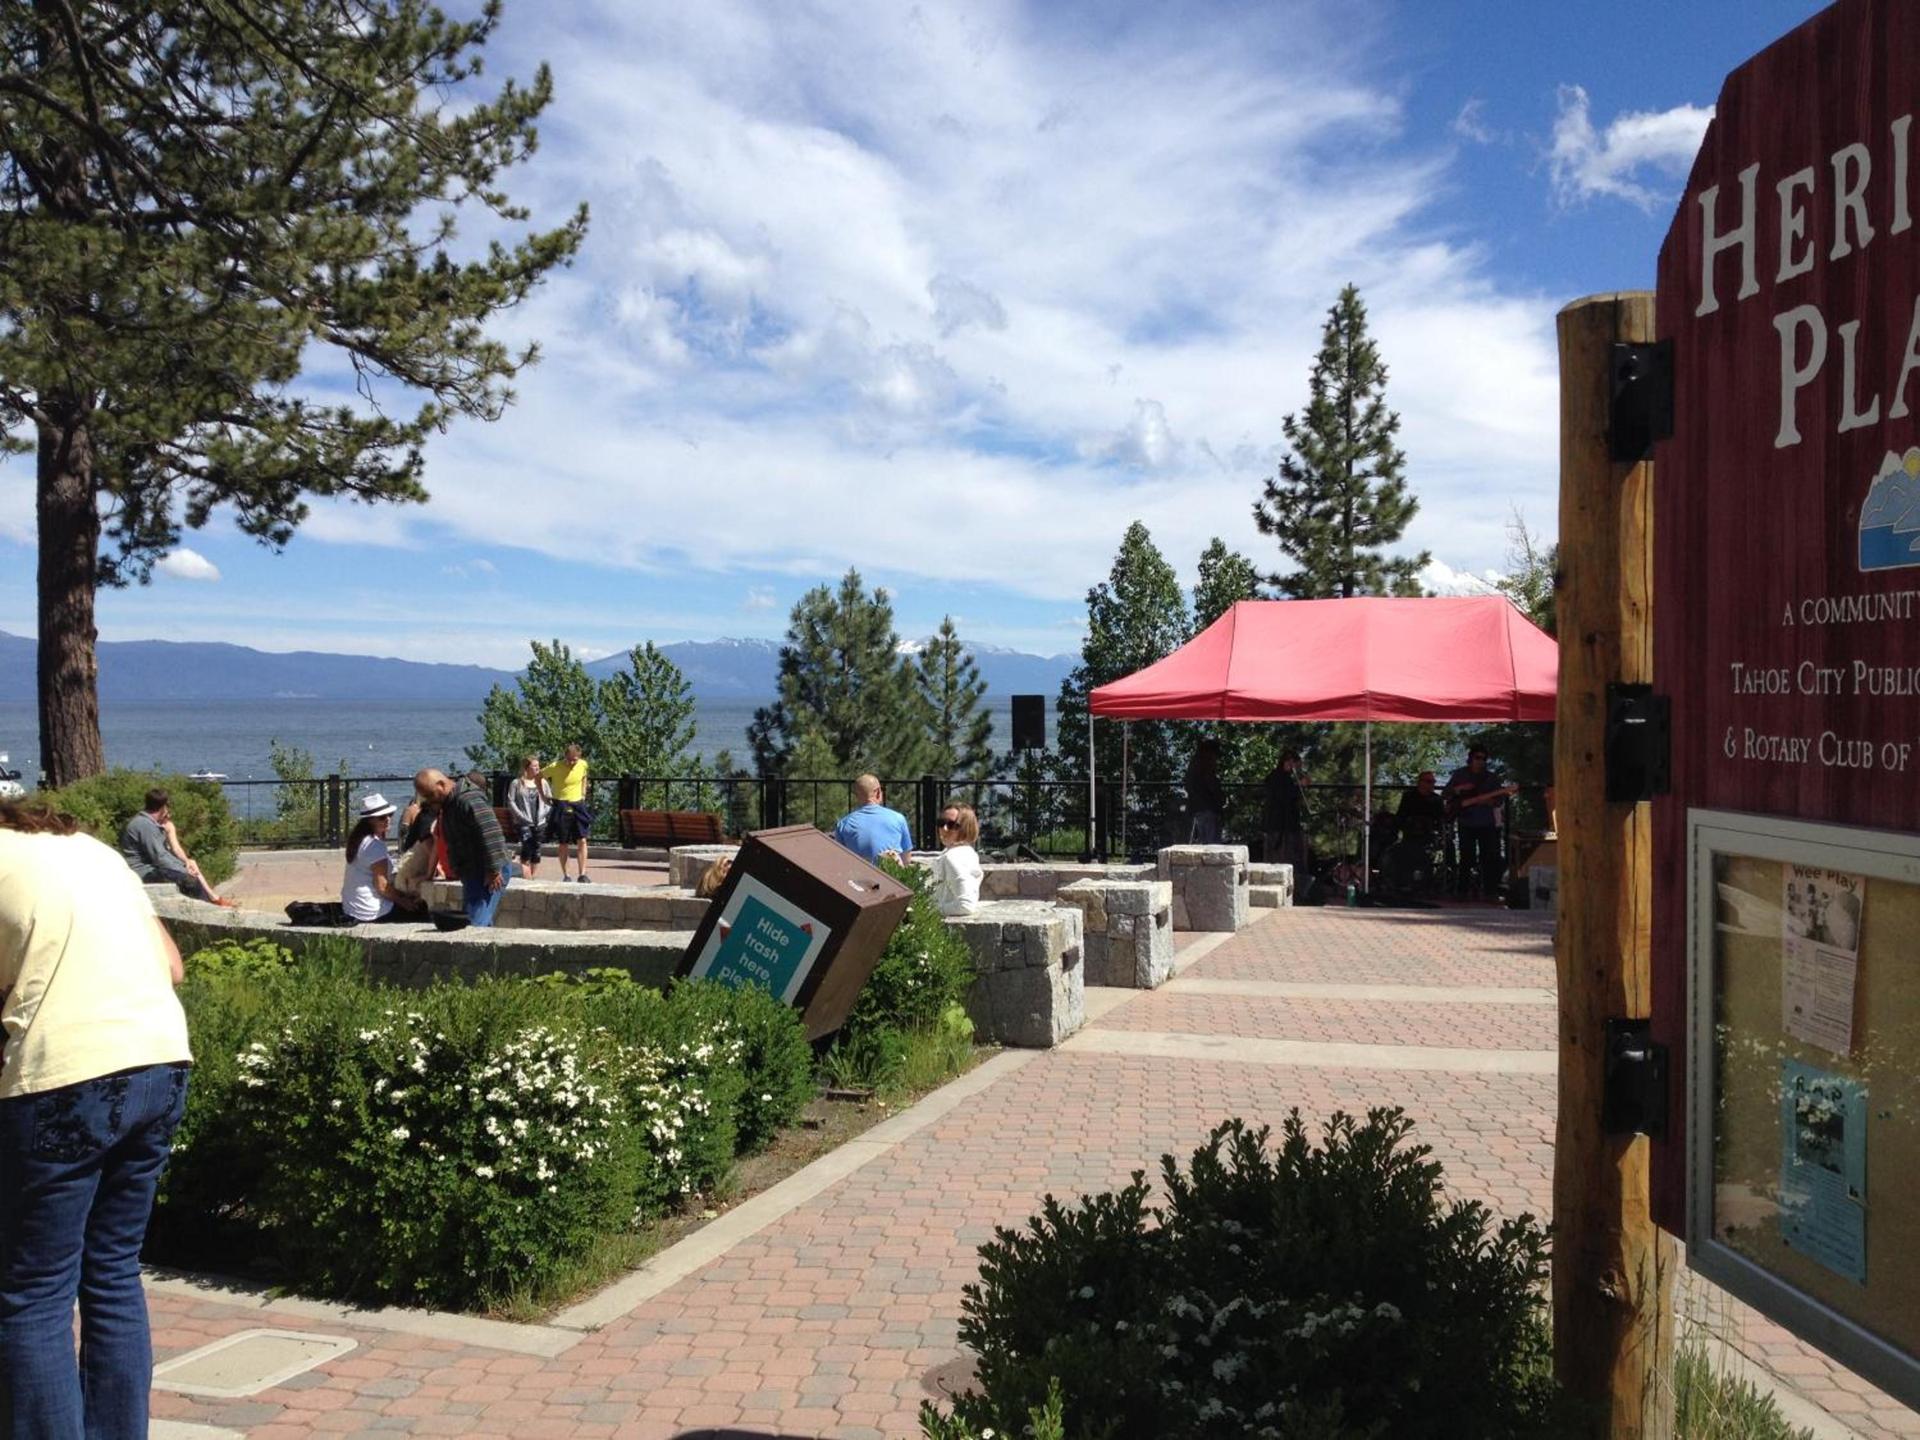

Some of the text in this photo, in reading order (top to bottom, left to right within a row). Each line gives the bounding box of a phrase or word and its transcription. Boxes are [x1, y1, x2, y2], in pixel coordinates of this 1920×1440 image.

[1695, 114, 1912, 317] HERI
[1783, 591, 1920, 626] A COMMUNIT
[1731, 663, 1791, 694] TAHOE
[1797, 660, 1846, 695] CITY
[1744, 727, 1812, 764] ROTARY
[1819, 731, 1873, 769] CLUB
[1882, 743, 1911, 771] OF
[744, 932, 779, 963] trash
[757, 917, 789, 946] Hide
